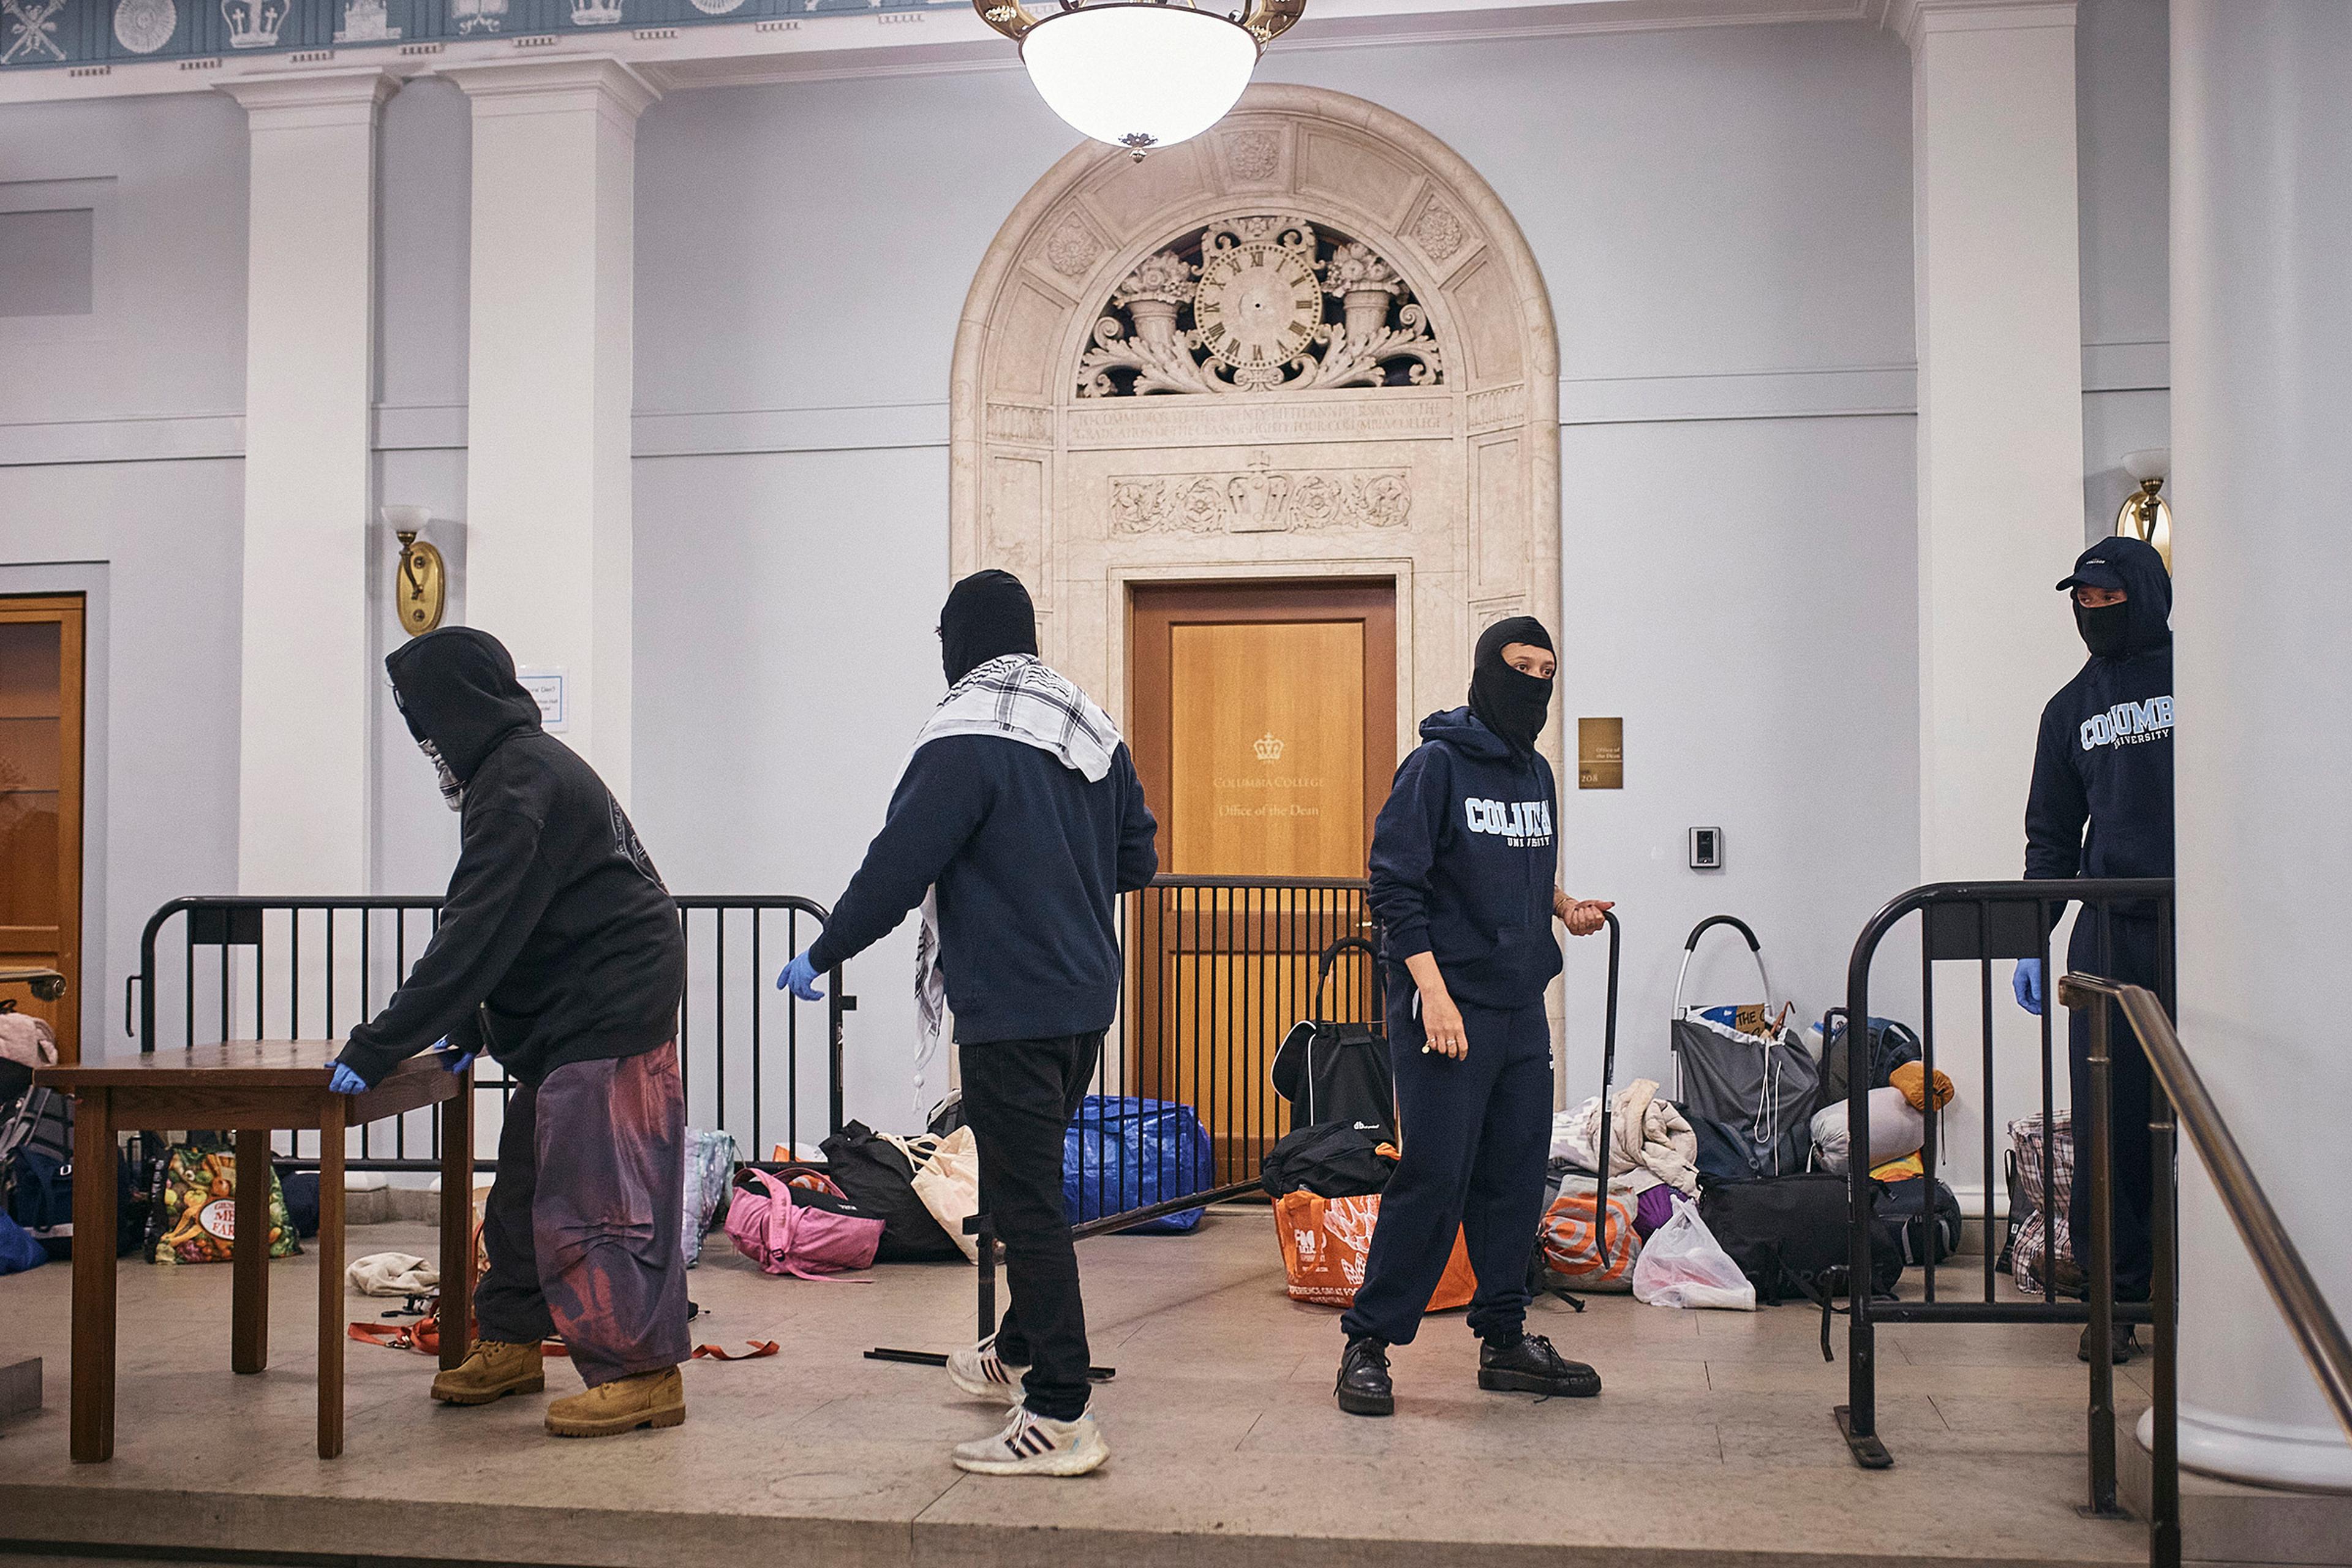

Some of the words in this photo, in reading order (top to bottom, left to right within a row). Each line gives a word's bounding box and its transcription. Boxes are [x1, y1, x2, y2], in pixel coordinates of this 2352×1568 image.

[1250, 251, 1264, 267] XII
[1226, 258, 1242, 276] XI
[1210, 277, 1226, 290] X
[1289, 275, 1306, 287] II
[1295, 300, 1313, 309] III
[1253, 344, 1264, 361] VI
[1276, 339, 1288, 354] V
[1218, 804, 1251, 817] Office
[1254, 804, 1267, 816] of
[1268, 804, 1287, 816] the
[1289, 804, 1319, 816] Dean
[1736, 1011, 1757, 1026] THE
